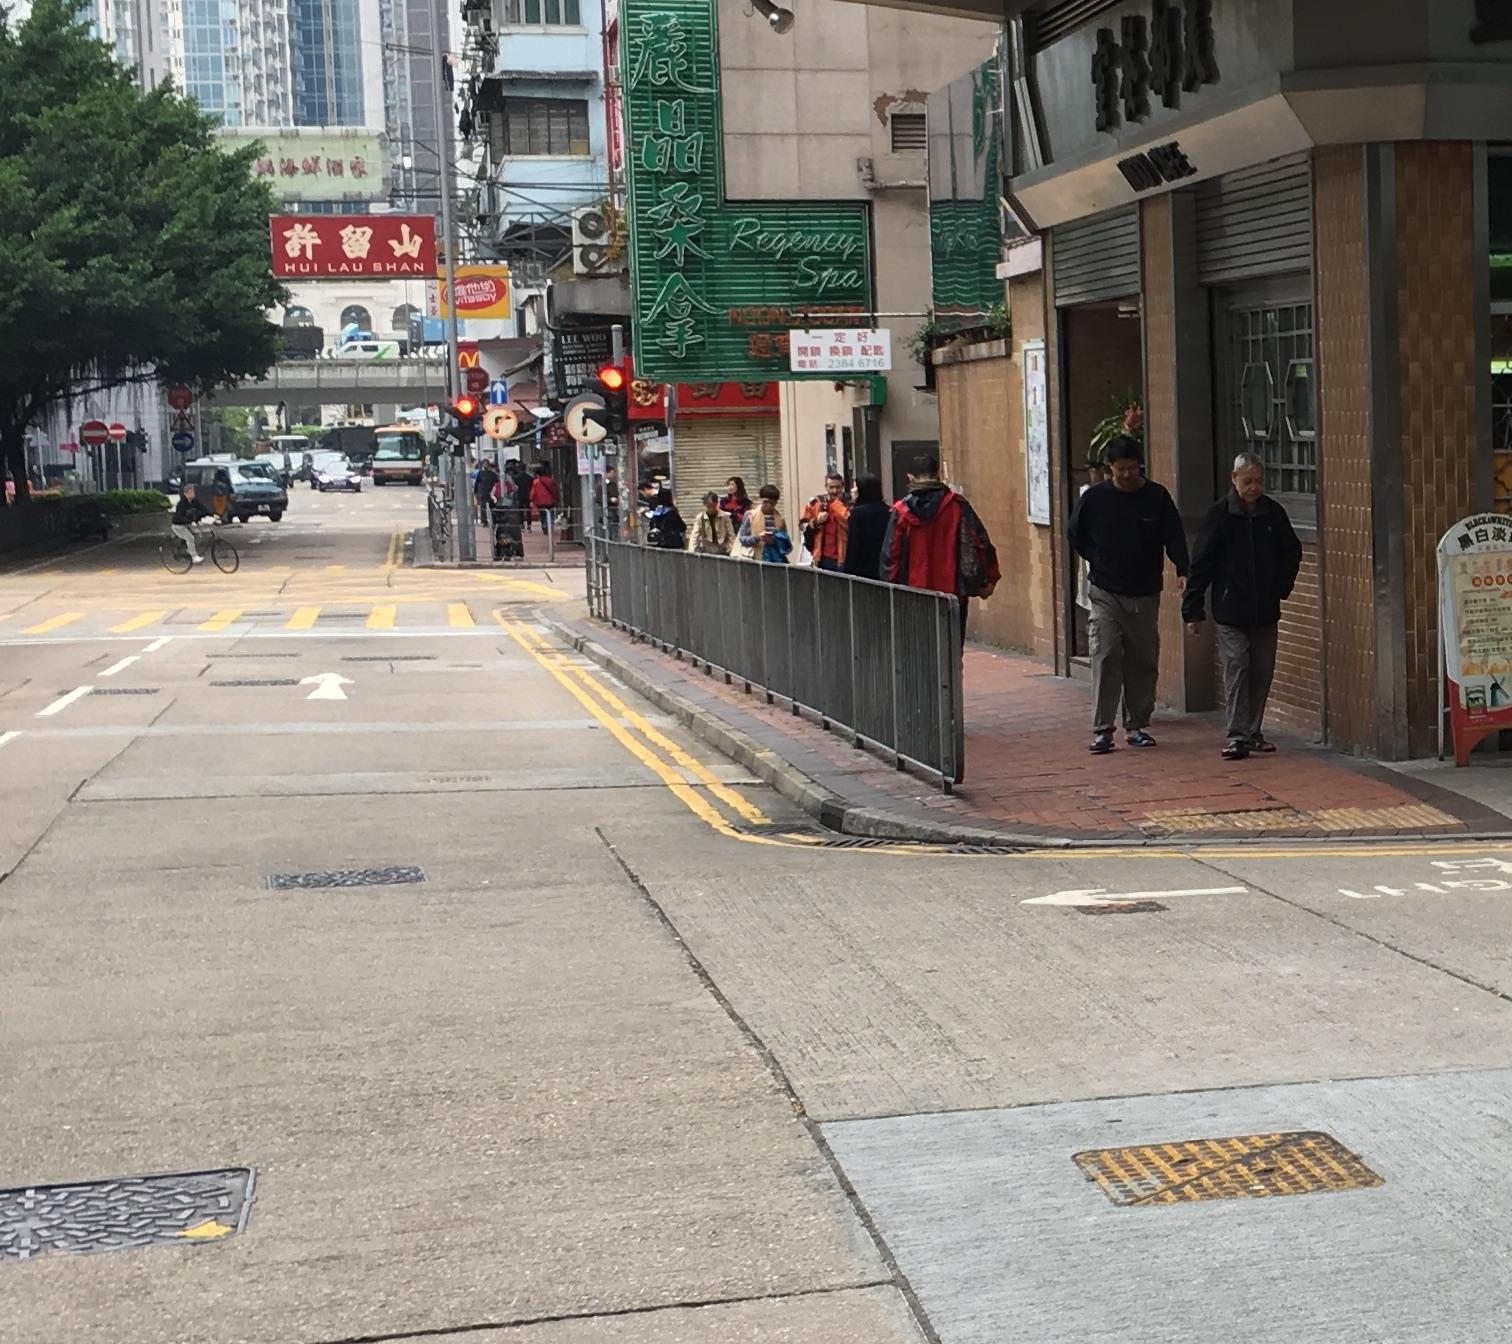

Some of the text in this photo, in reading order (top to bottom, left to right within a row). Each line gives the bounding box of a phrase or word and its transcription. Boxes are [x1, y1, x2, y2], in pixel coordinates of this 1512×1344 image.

[282, 223, 424, 261] 許留山
[729, 218, 861, 260] Regency
[284, 262, 425, 273] HUI LAU SHAN
[794, 256, 864, 296] Spa
[811, 331, 870, 344] 一定好
[828, 359, 854, 369] 2384
[858, 358, 885, 368] 6716
